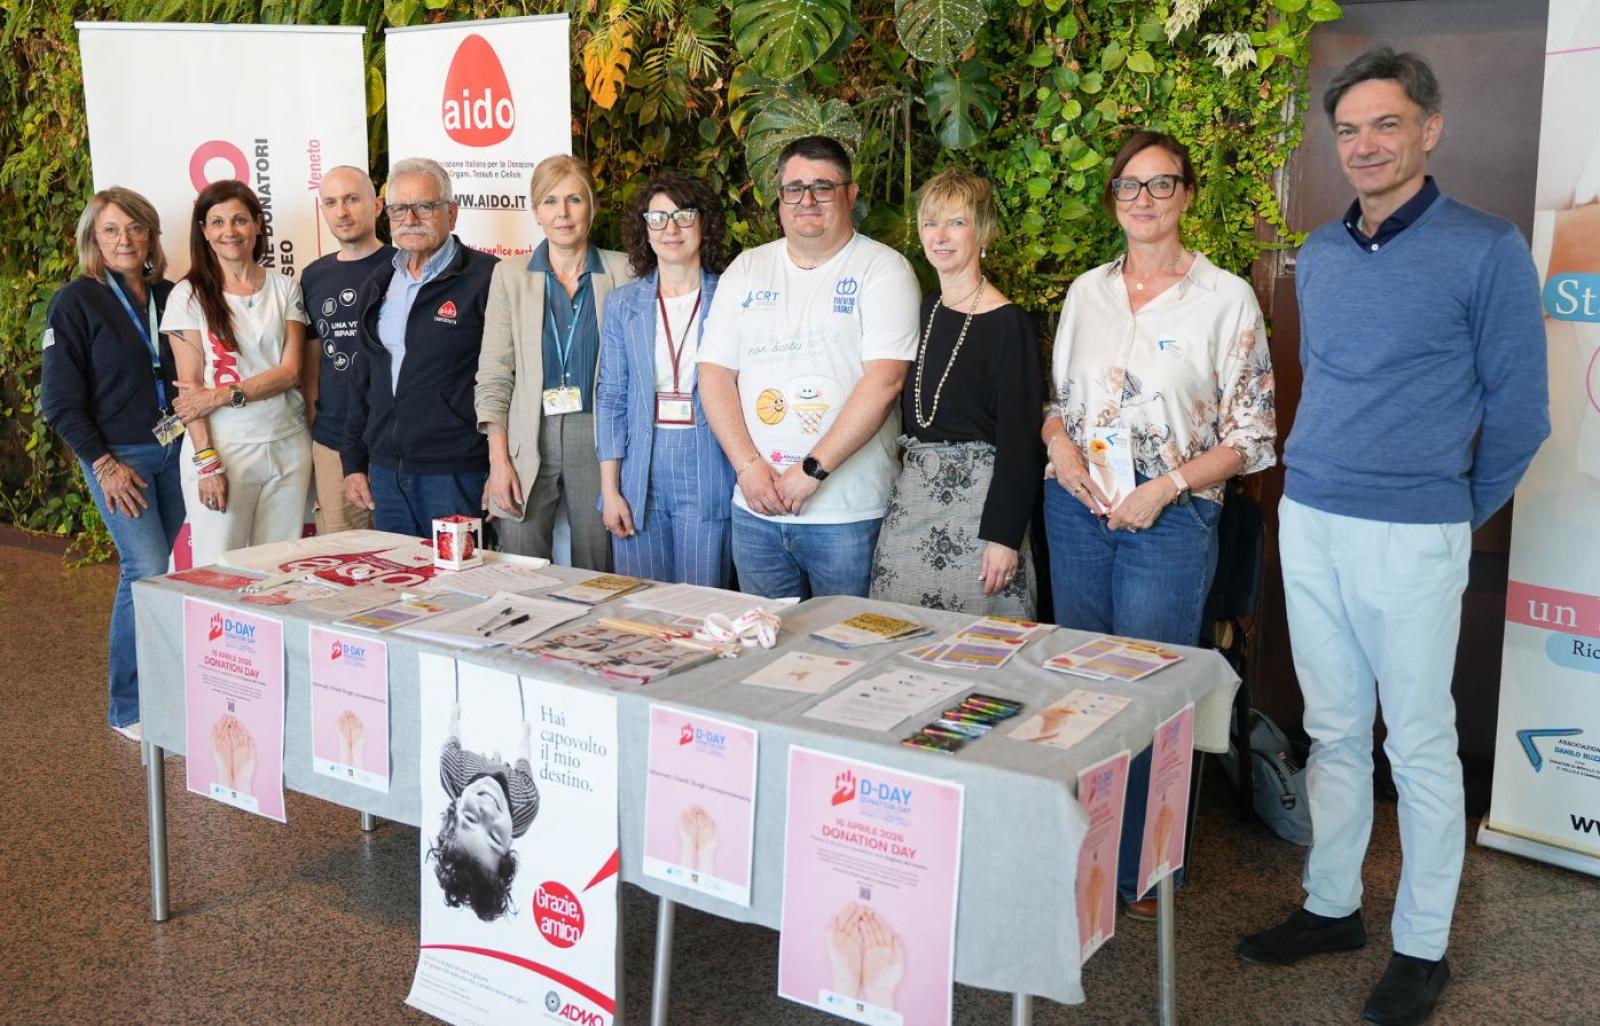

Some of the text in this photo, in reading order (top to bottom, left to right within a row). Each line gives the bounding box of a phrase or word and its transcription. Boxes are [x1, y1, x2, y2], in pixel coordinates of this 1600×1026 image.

[443, 87, 515, 130] aido
[307, 139, 322, 191] Veneto
[756, 290, 779, 301] CRT
[1555, 279, 1600, 315] St
[1528, 600, 1578, 628] un
[225, 619, 255, 637] D-DAY
[343, 644, 365, 656] D-DAY
[1573, 639, 1600, 660] Ric
[204, 655, 244, 674] DONATION
[244, 666, 260, 679] DAY
[540, 705, 566, 727] Hai
[540, 730, 607, 757] capovolto
[696, 728, 726, 744] D-DAY
[541, 743, 581, 769] il mio
[540, 762, 594, 793] destino.
[860, 778, 912, 805] D-DAY
[822, 825, 888, 853] DONATION
[890, 843, 917, 859] DAY
[846, 820, 878, 836] APRILE
[879, 828, 904, 843] 2026
[536, 885, 580, 922] Grazie,
[541, 916, 581, 944] amico
[559, 1003, 604, 1026] ADMO
